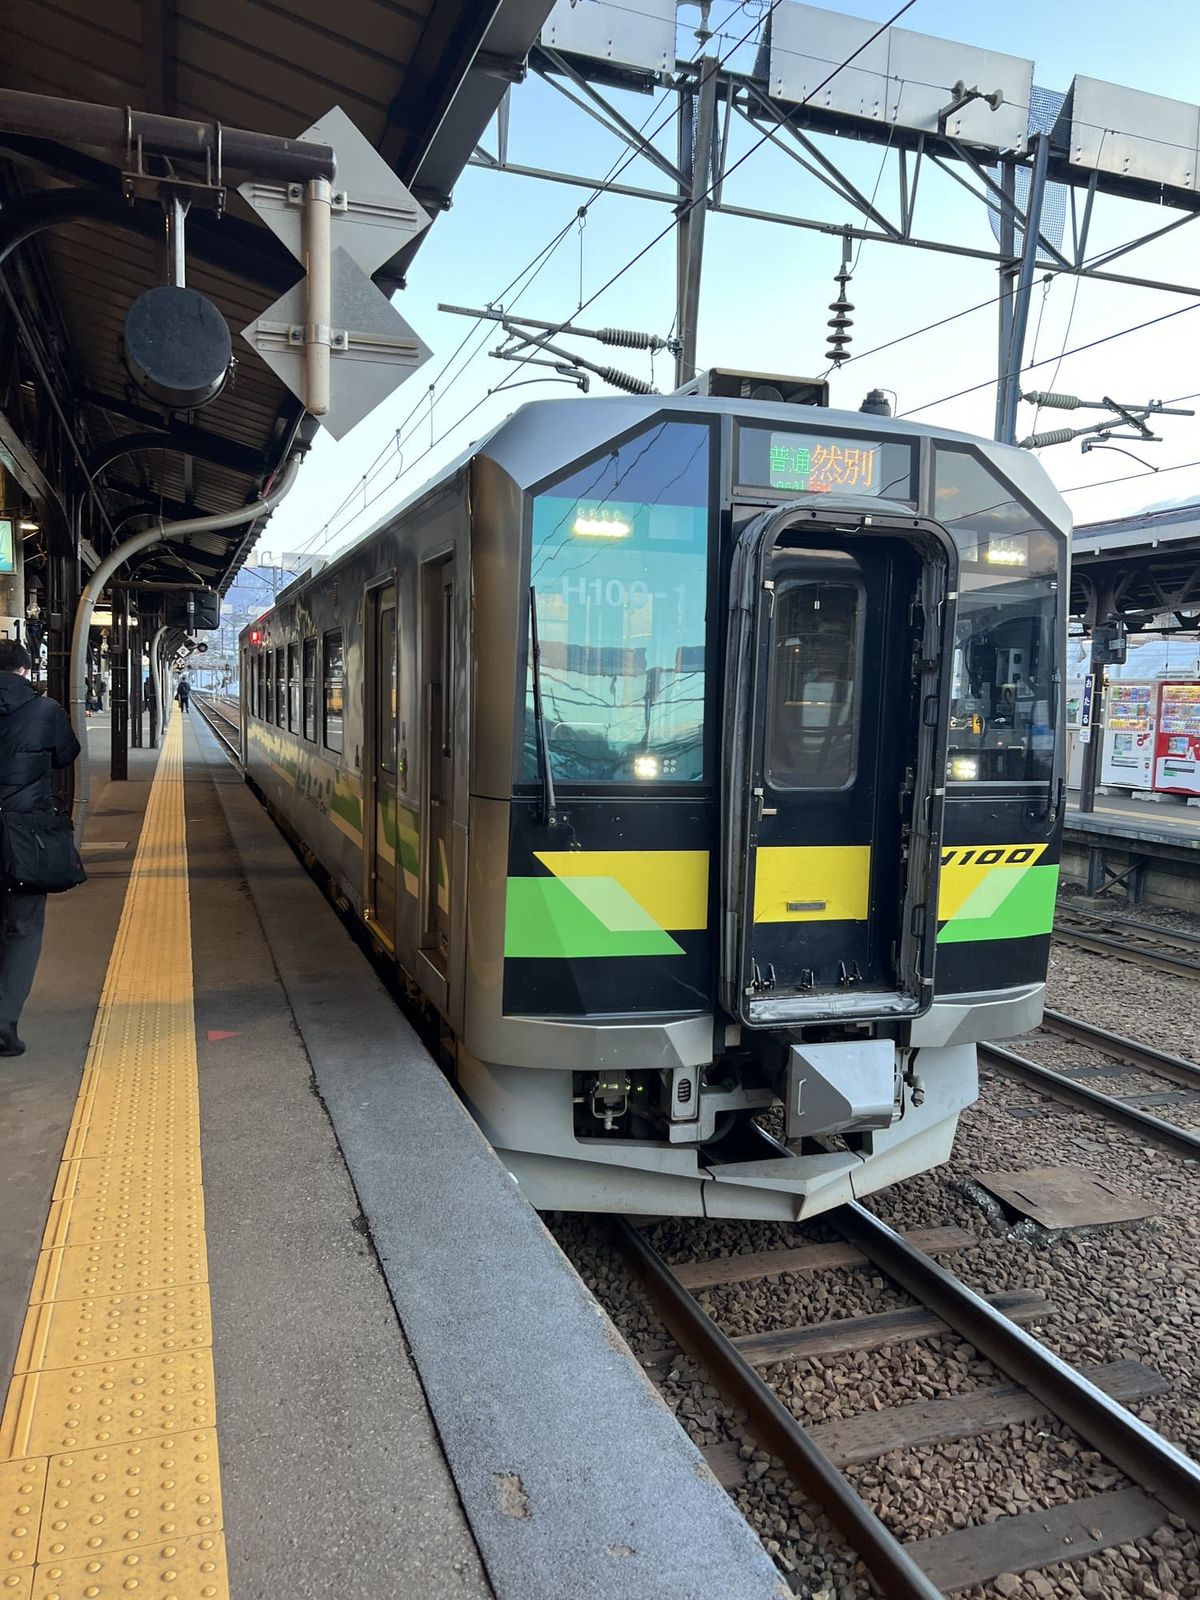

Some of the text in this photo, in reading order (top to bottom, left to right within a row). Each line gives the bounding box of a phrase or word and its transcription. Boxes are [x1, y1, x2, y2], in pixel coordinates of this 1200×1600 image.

[770, 444, 873, 487] 普通 然別
[561, 575, 687, 611] H100-1
[1082, 678, 1093, 724] おたる
